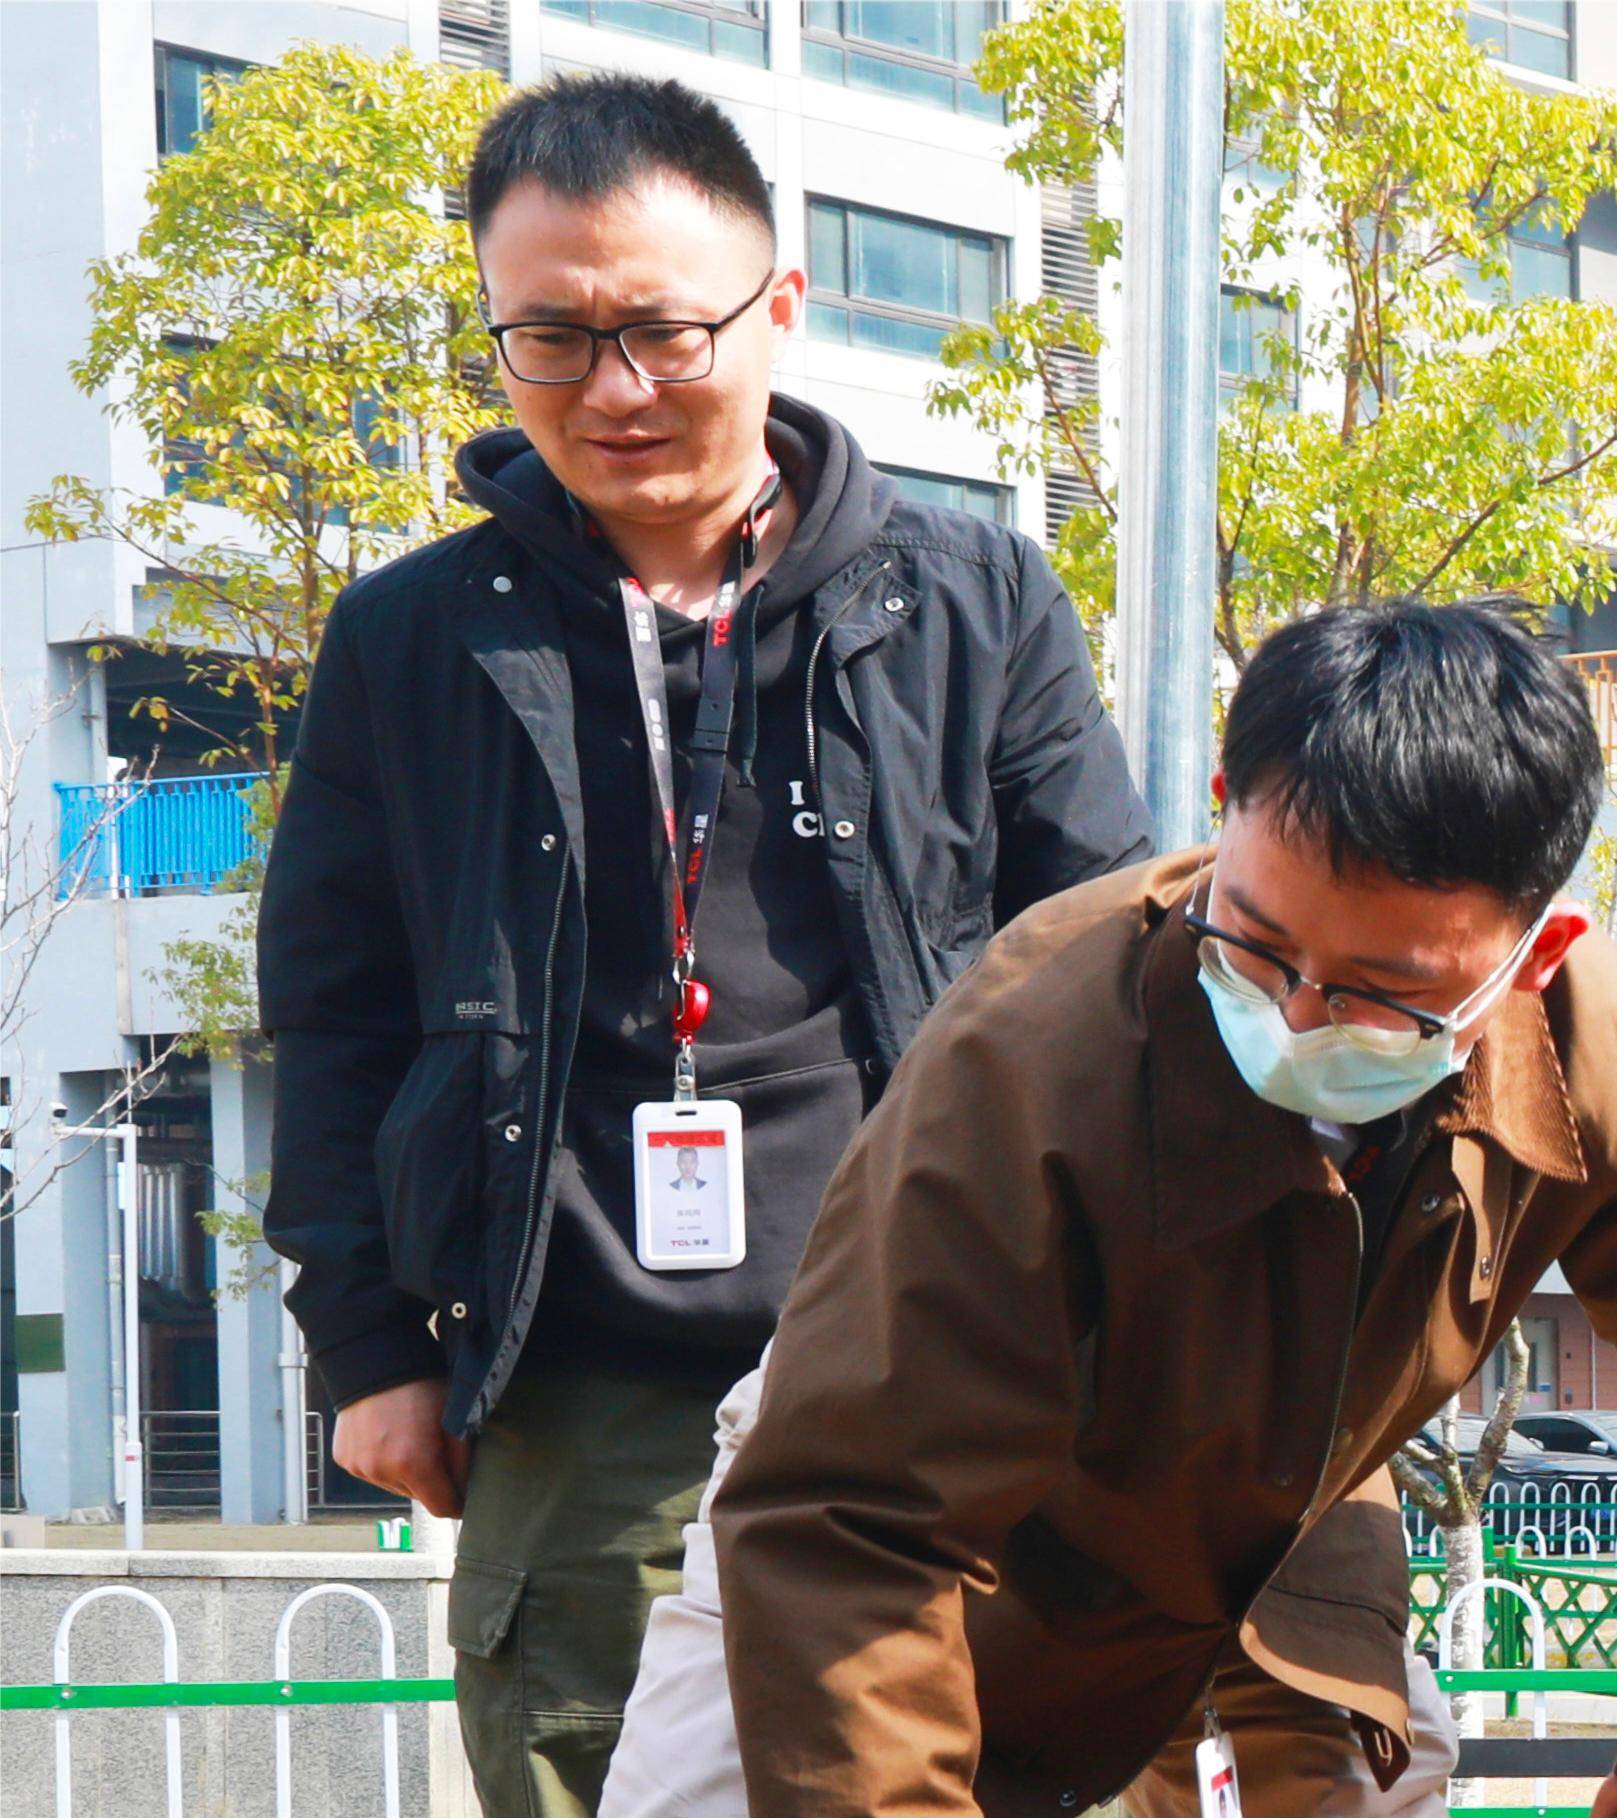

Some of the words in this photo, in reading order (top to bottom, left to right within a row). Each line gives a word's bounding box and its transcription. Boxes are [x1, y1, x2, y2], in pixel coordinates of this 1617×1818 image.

[713, 608, 733, 648] TCL
[789, 781, 805, 805] I
[687, 848, 704, 884] TCL
[671, 1239, 691, 1247] TCL
